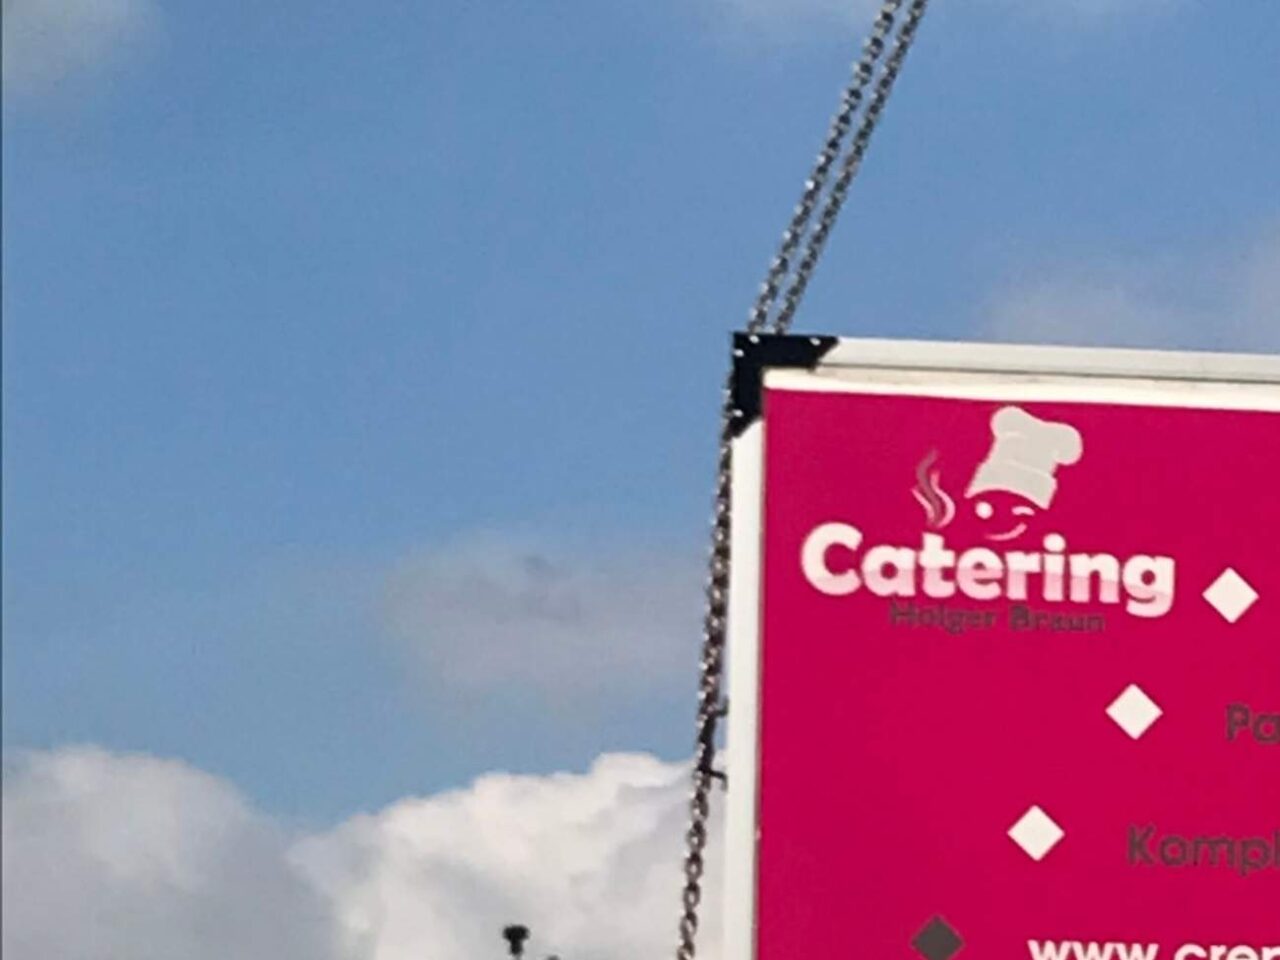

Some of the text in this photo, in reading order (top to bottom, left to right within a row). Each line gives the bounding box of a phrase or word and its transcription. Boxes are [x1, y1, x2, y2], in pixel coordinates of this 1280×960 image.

[800, 521, 1176, 618] Catering
[888, 600, 1106, 634] Holger Braun
